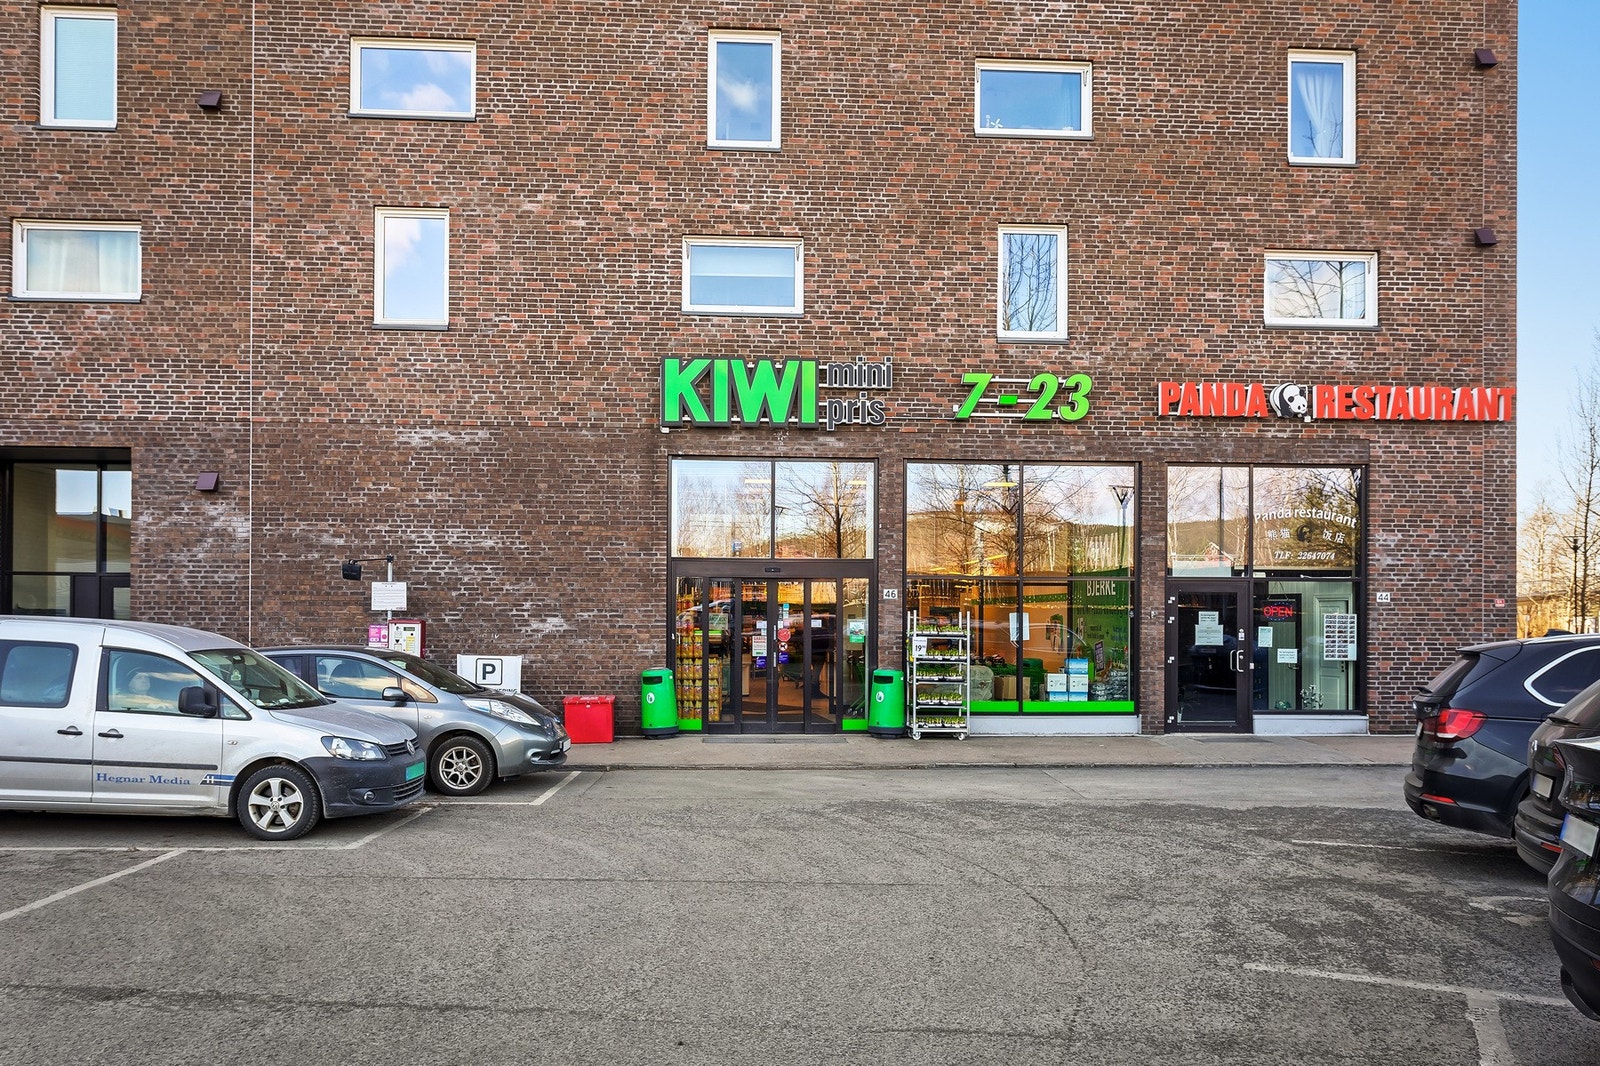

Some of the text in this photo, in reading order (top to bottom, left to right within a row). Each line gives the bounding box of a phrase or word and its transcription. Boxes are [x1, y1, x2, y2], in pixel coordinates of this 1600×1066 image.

[827, 356, 893, 389] mini
[662, 356, 819, 428] KIWI
[1158, 381, 1517, 422] PANDA RESTAURANT
[827, 391, 886, 431] pris
[1294, 508, 1357, 528] restaurant
[885, 590, 896, 598] 46
[1086, 580, 1116, 597] BJERKE
[1378, 593, 1389, 601] 44
[1263, 606, 1293, 617] OPEN
[482, 663, 496, 680] P
[96, 772, 146, 784] Hegnar
[149, 775, 190, 785] Media
